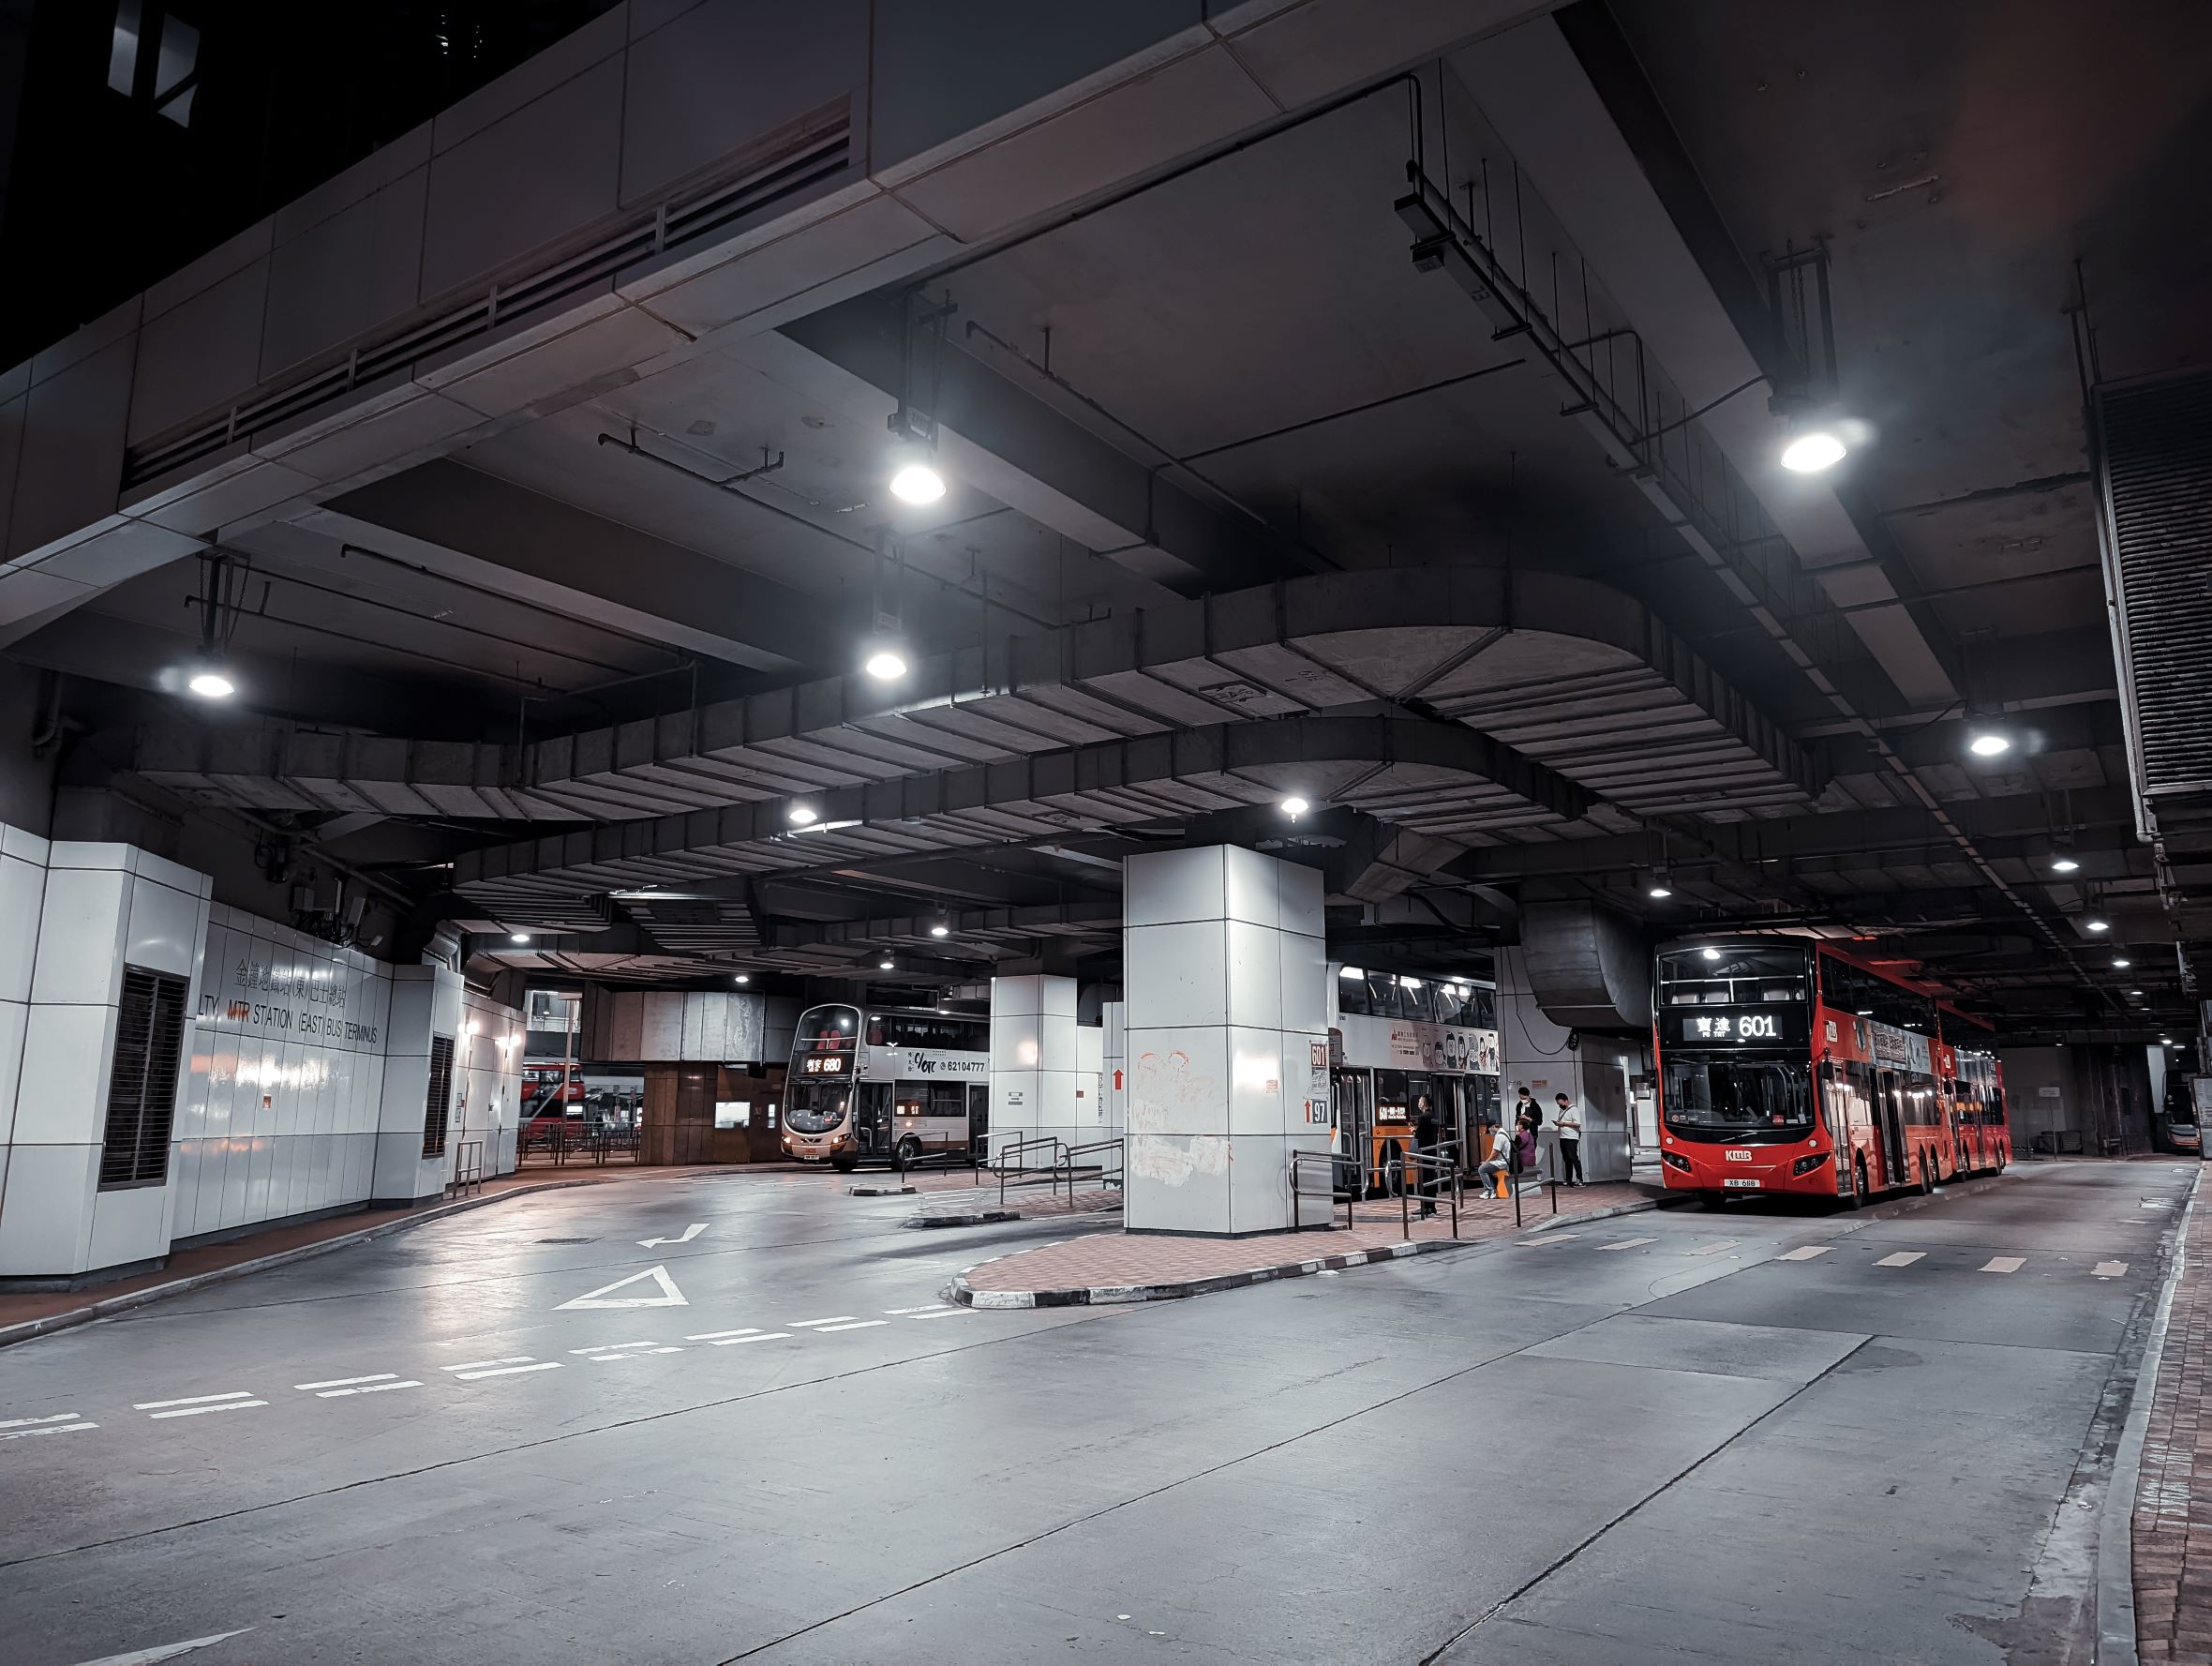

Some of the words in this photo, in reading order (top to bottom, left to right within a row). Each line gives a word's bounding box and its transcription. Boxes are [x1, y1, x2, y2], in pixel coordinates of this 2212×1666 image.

[227, 999, 250, 1023] MTR
[253, 1004, 293, 1029] STATION
[298, 1010, 325, 1036] (EAST)
[326, 1017, 342, 1038] BUS
[344, 1021, 378, 1043] TERMINUS
[1739, 1015, 1777, 1037] 601
[823, 1058, 841, 1072] 680
[1312, 1045, 1325, 1066] 601
[948, 1061, 985, 1073] 62104777
[1314, 1102, 1325, 1122] 97
[1725, 1149, 1753, 1162] KMB
